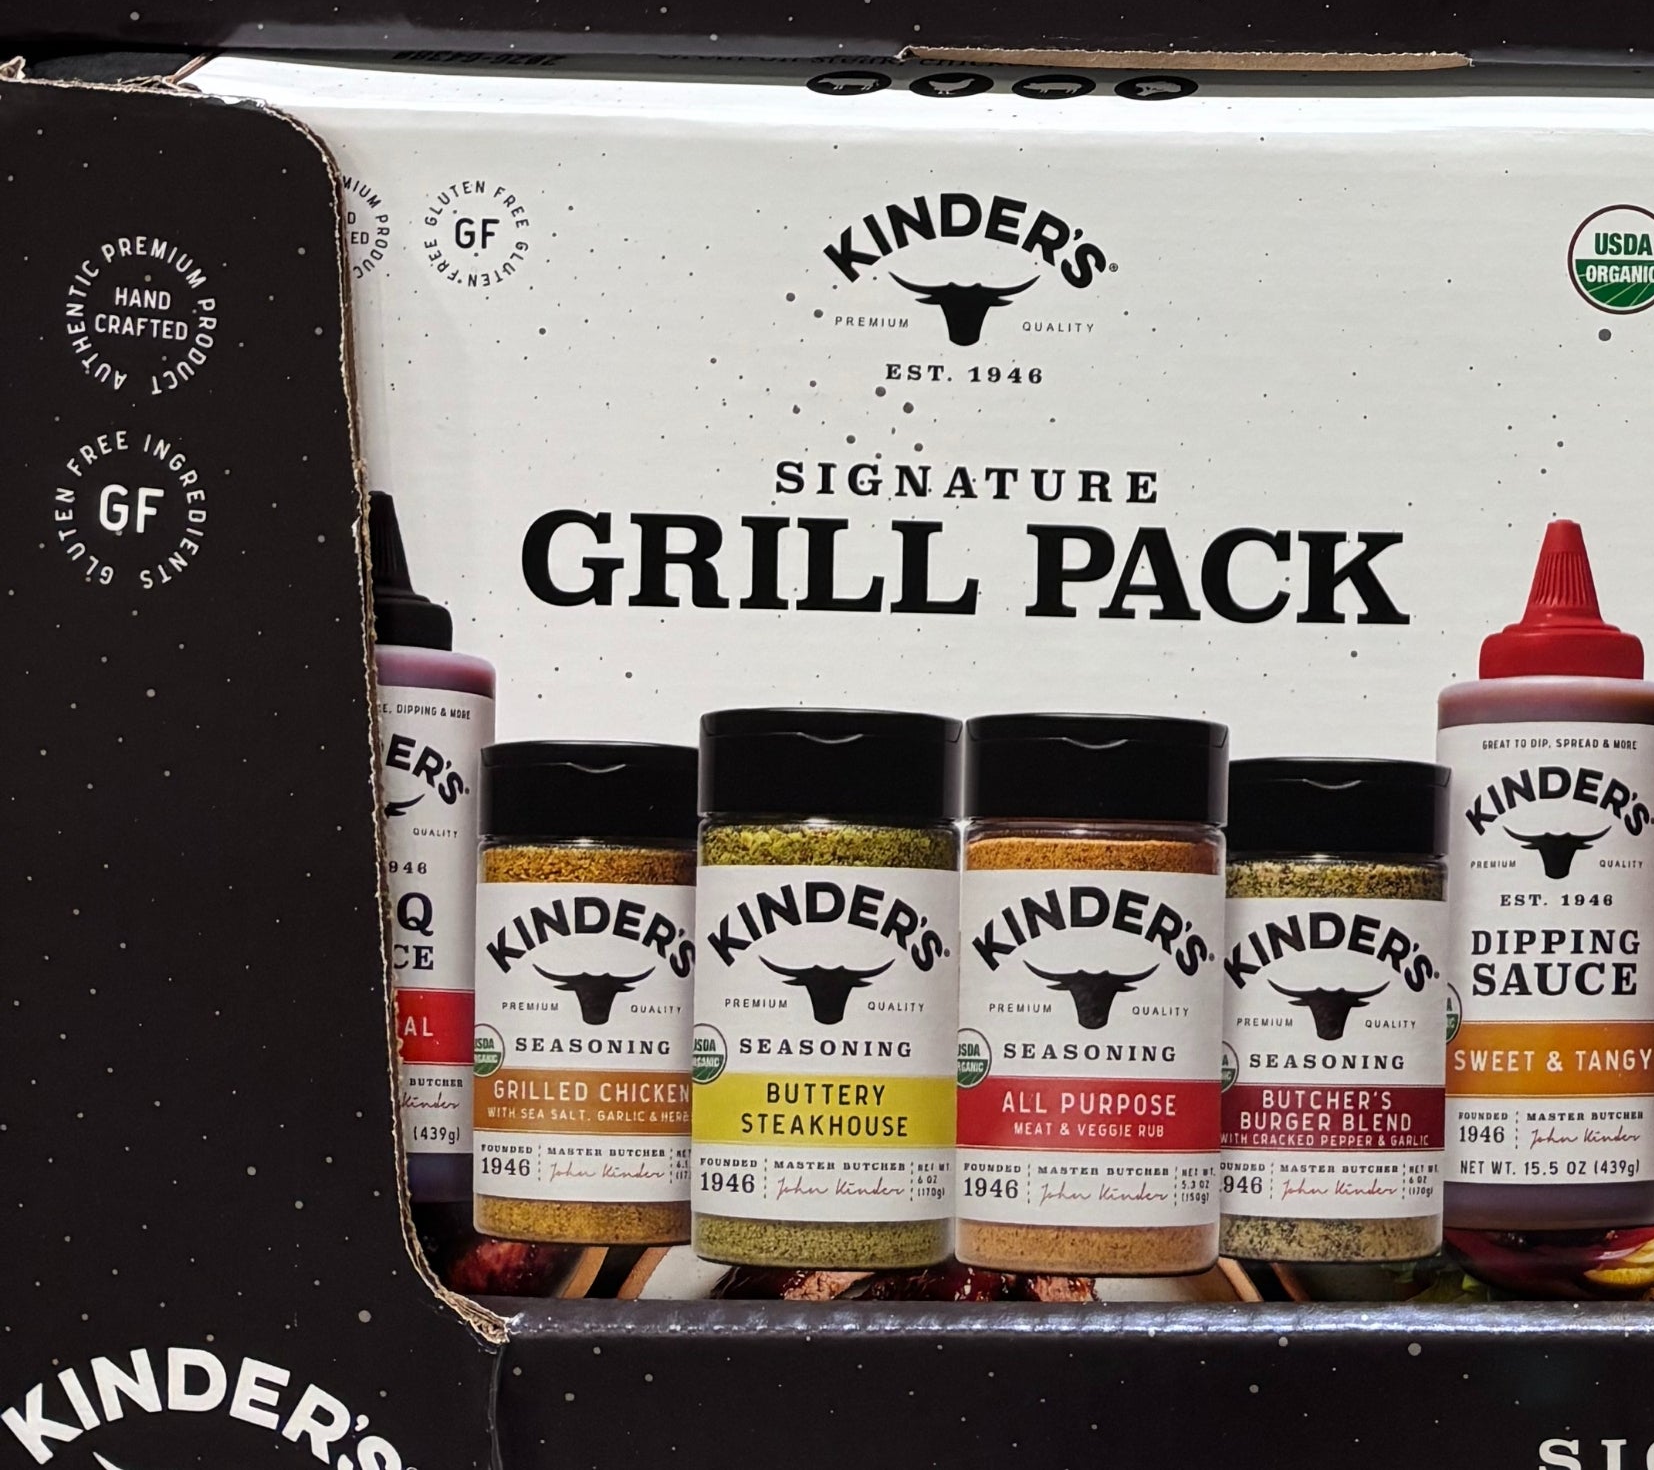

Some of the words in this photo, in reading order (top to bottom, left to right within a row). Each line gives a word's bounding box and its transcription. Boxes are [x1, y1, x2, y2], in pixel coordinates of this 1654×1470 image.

[823, 192, 1107, 289] KINDER'S
[1595, 232, 1653, 256] USDA
[114, 287, 173, 310] HAND
[94, 313, 189, 341] CRAFTED
[886, 363, 953, 381] EST.
[967, 366, 1043, 384] 1946
[775, 460, 1161, 507] SIGNATURE
[98, 483, 165, 534] GF
[520, 508, 981, 617] GRILL
[1024, 521, 1413, 627] PACK
[1465, 766, 1650, 836] KINDER'S
[1471, 929, 1640, 956] DIPPING
[1472, 962, 1638, 996] SAUCE
[493, 1079, 589, 1102] GRILLED
[600, 1082, 691, 1104] CHICKEN
[1263, 1090, 1393, 1110] BUTCHER'S
[1240, 1112, 1332, 1131] BURGER
[1342, 1112, 1412, 1132] BLEND
